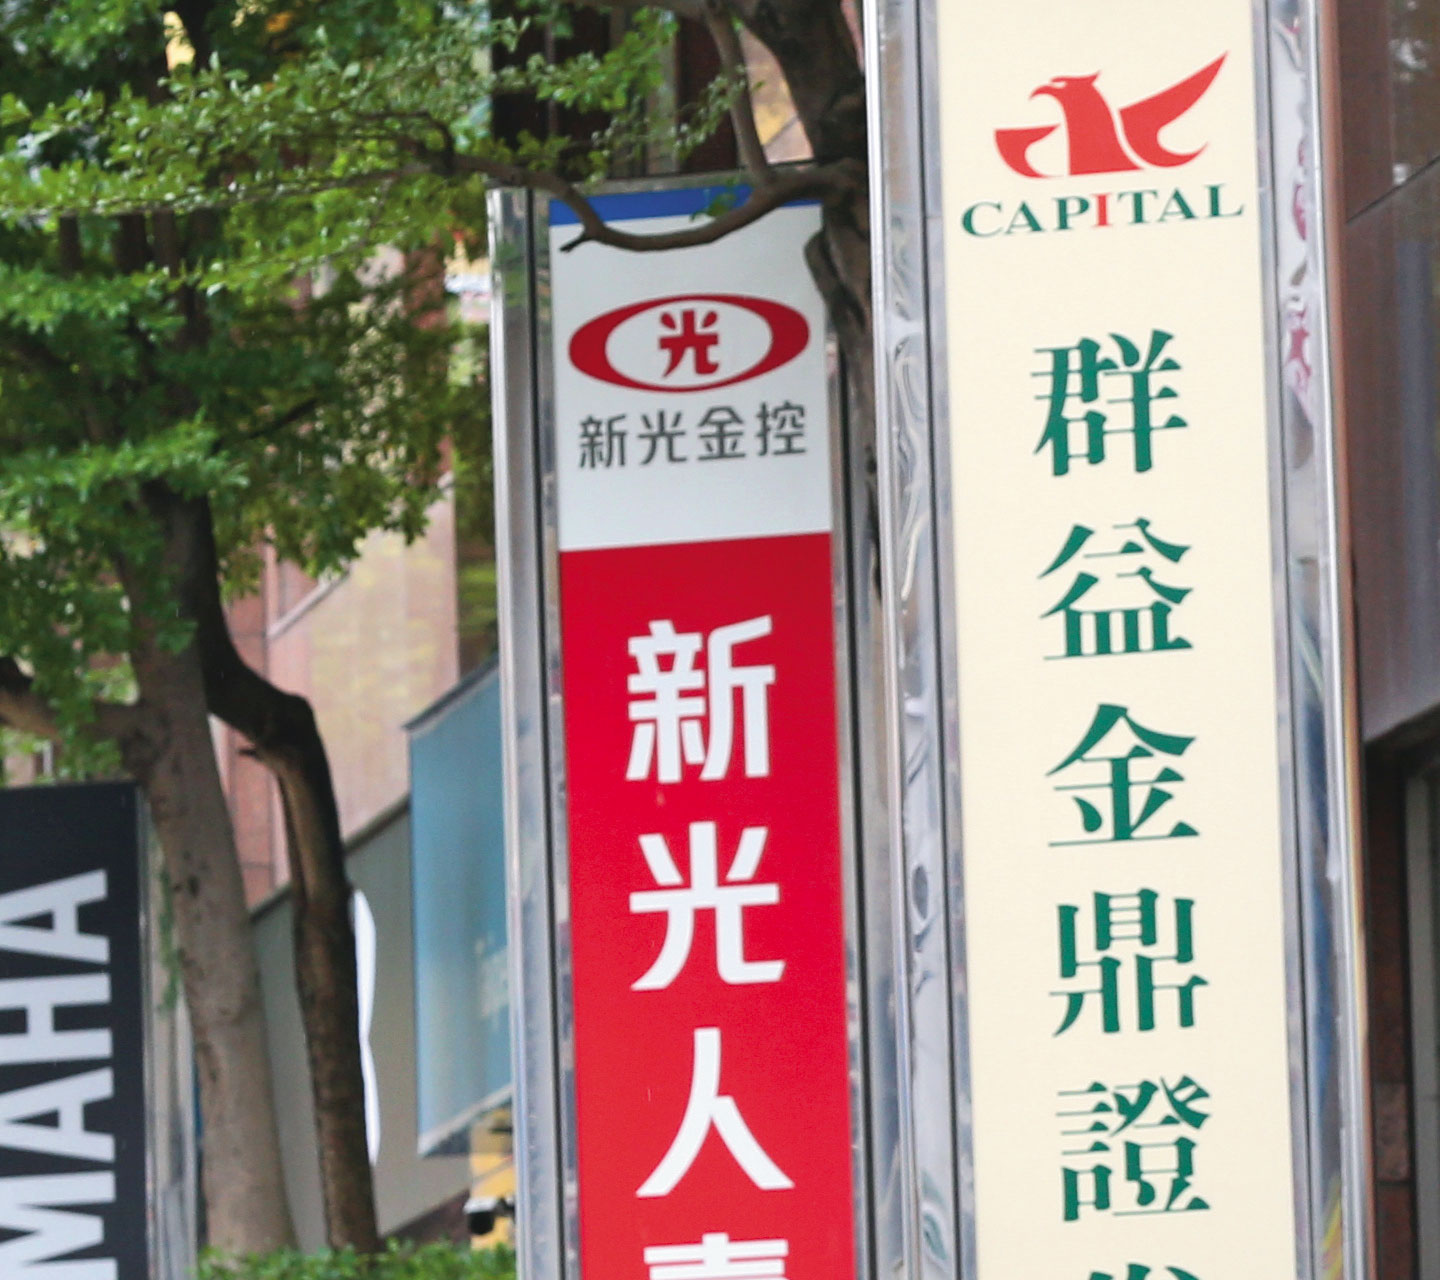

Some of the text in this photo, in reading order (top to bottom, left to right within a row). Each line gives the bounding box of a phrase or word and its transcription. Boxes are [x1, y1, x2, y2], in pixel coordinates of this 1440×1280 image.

[961, 182, 1245, 238] CAPITAL
[578, 400, 807, 470] 新光金控
